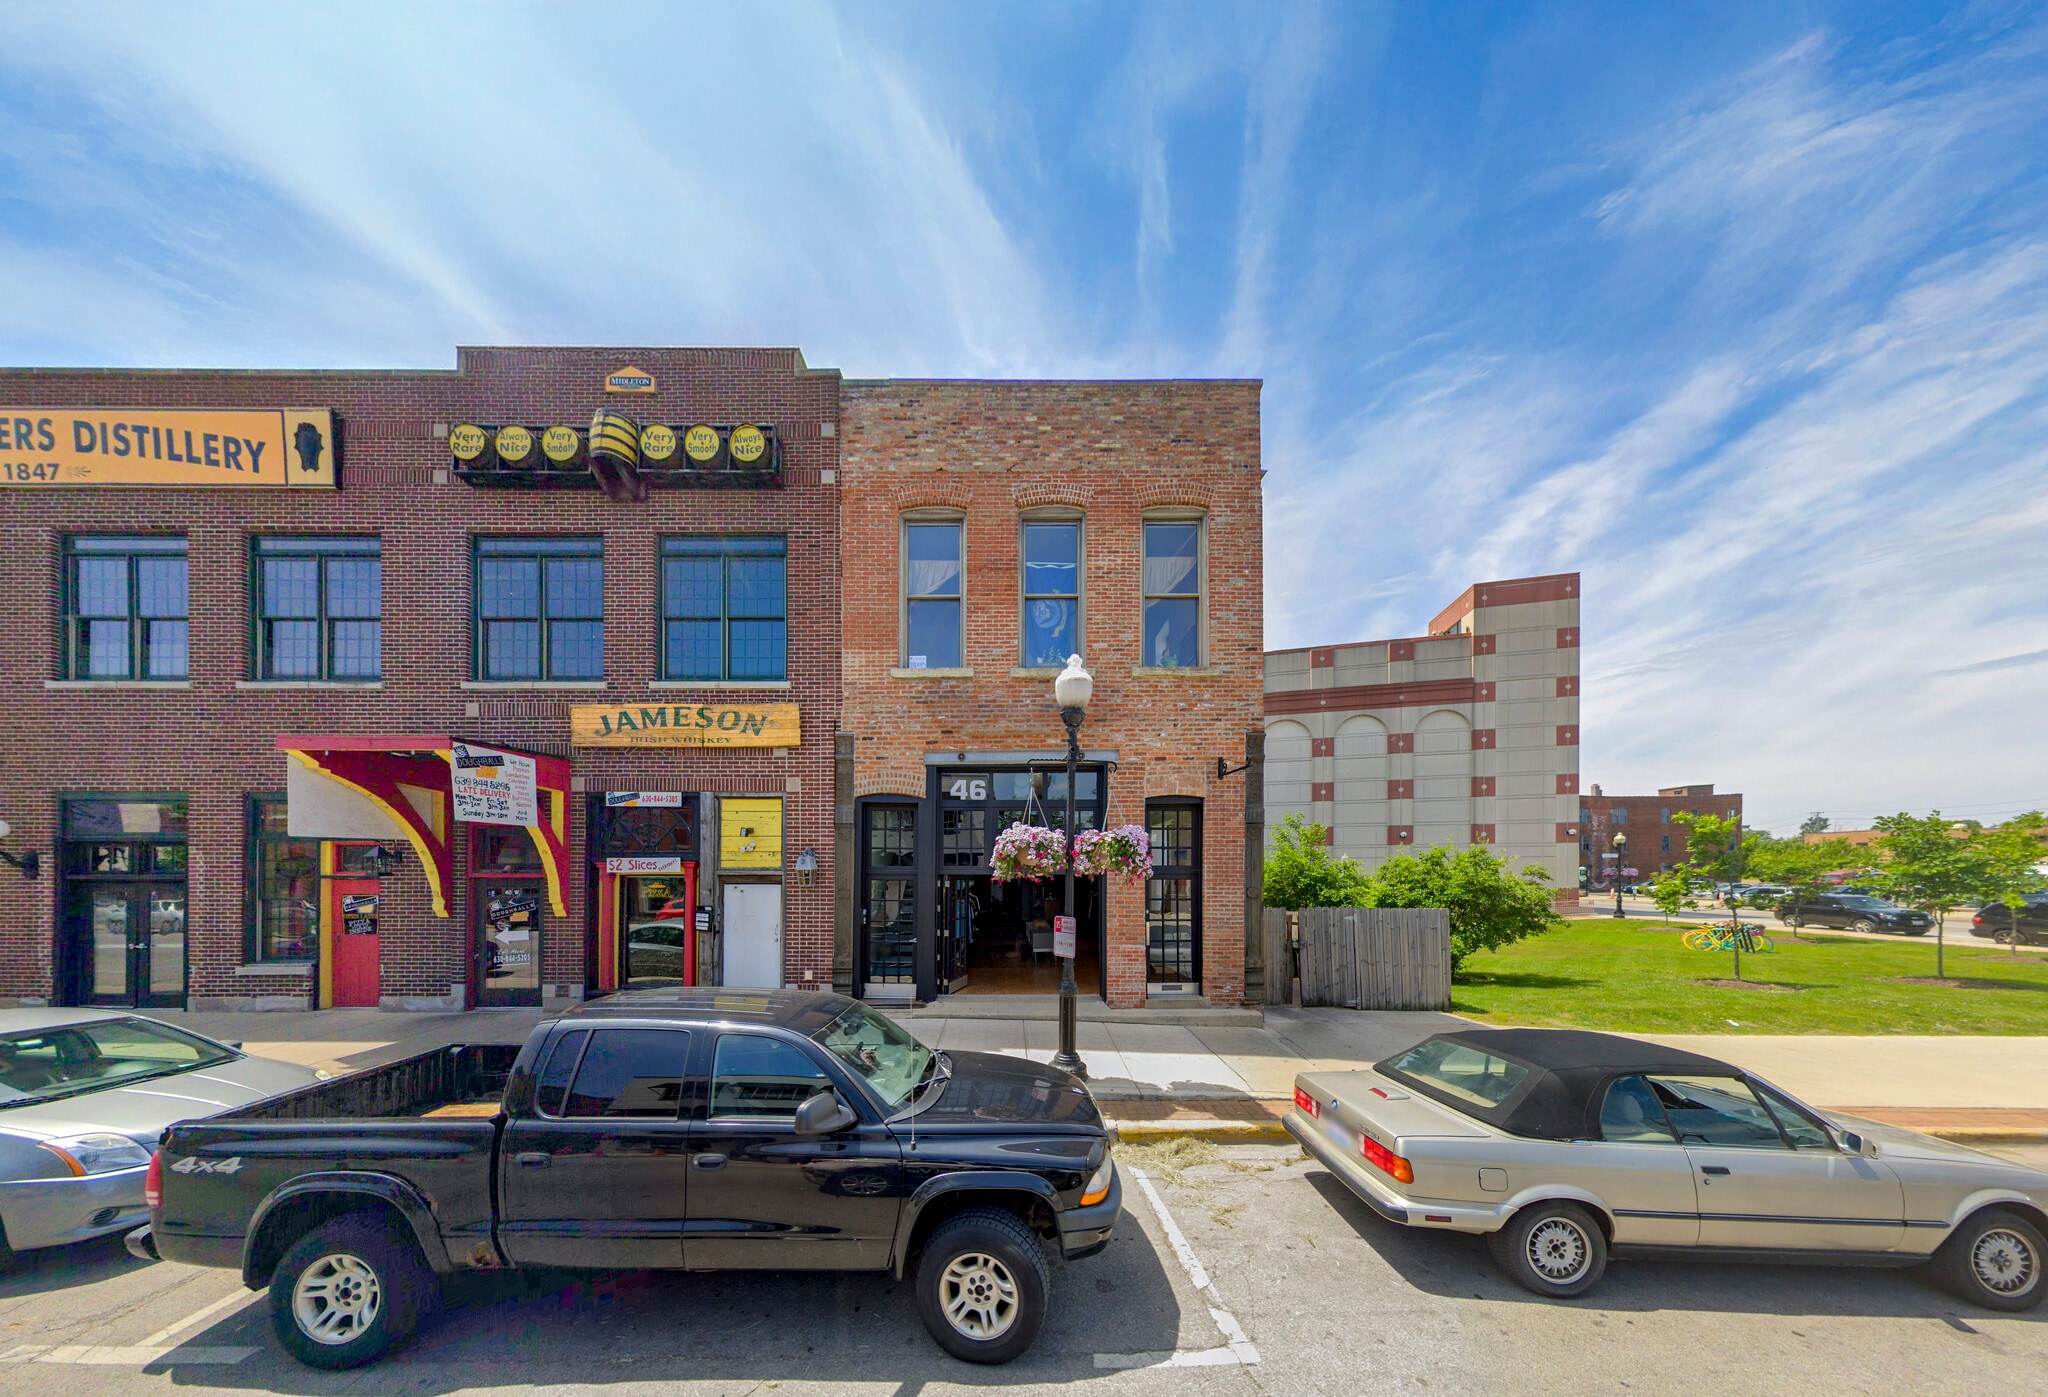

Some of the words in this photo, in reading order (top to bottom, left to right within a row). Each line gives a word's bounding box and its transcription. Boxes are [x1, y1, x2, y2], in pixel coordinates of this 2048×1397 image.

[611, 377, 650, 385] MIDLETON
[454, 431, 482, 442] Very
[500, 432, 529, 444] Always
[550, 431, 573, 443] Very
[644, 431, 675, 443] Very
[690, 430, 714, 443] Very
[734, 434, 762, 444] Always
[73, 419, 266, 474] DISTILLERY
[452, 442, 482, 453] Rare
[500, 444, 528, 452] Nice
[546, 443, 576, 453] Smooth
[643, 441, 673, 453] Rare
[688, 444, 717, 454] Smooth
[734, 444, 763, 455] Nice
[3, 462, 60, 481] 1847
[593, 705, 769, 737] JAMESON
[630, 736, 667, 744] IRISH
[671, 736, 732, 744] WHISKEY
[456, 756, 504, 768] DOUGHBALLS
[458, 786, 477, 795] LATE
[480, 788, 511, 798] DELIVERY
[950, 779, 987, 800] 46
[463, 808, 484, 818] Sunday
[608, 858, 623, 871] $2
[628, 859, 658, 871] Slices
[491, 902, 536, 919] DOUGHBALLS
[169, 1156, 244, 1174] 4x4
